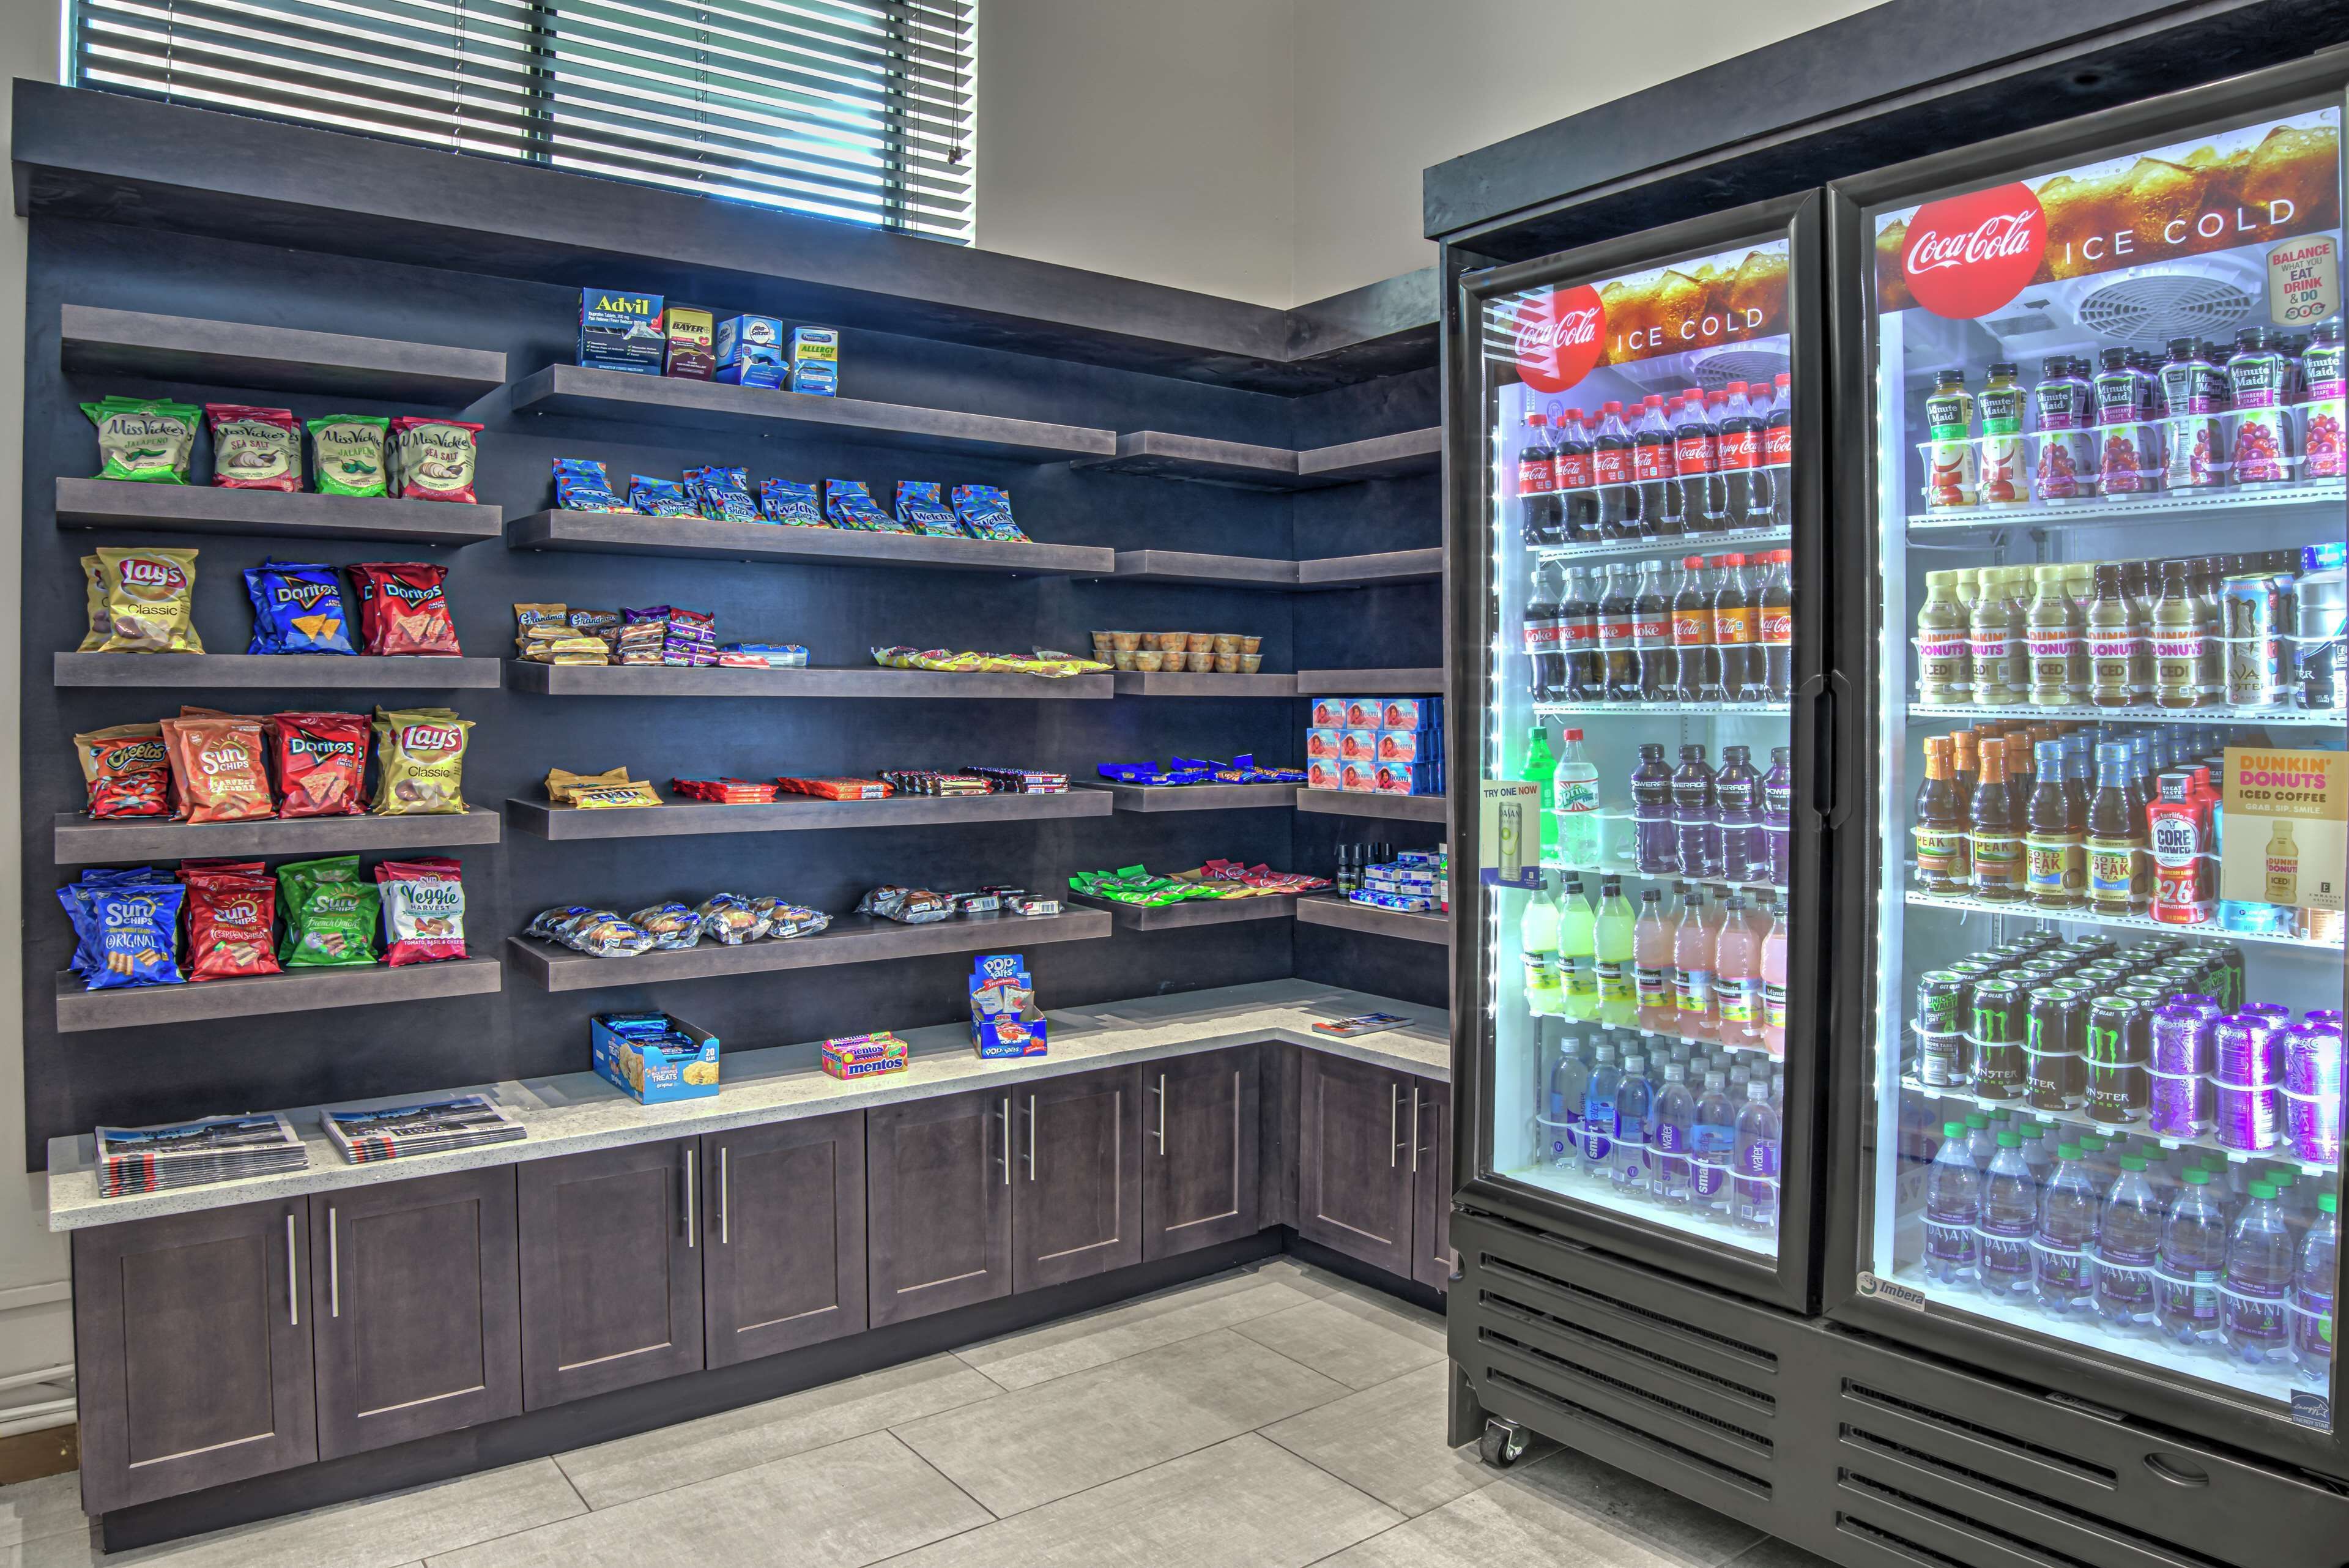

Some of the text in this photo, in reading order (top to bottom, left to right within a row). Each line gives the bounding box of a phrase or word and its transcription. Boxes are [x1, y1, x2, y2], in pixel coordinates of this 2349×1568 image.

[2065, 199, 2295, 265] ICE COLD
[1907, 208, 2039, 275] Coca-Cola
[2272, 243, 2331, 266] BALANCE
[2281, 256, 2323, 272] WHAT YOU
[2284, 277, 2323, 294] DRINK
[2290, 289, 2318, 304] & DO
[595, 295, 649, 315] Advil
[672, 322, 703, 333] BAYER
[1514, 305, 1600, 355] Coca-Cola
[1617, 308, 1763, 353] ICE COLD
[2303, 357, 2340, 370] Minute
[2232, 366, 2270, 378] Minute
[2235, 376, 2265, 387] Maid
[2098, 384, 2132, 395] Minute
[2100, 391, 2131, 403] Maid
[2041, 401, 2065, 410] Maid
[1932, 414, 1954, 422] Maid
[231, 440, 270, 450] SEA SALT
[425, 448, 459, 461] SEA SALT
[1679, 445, 1715, 461] Coca-Cola
[916, 511, 955, 521] Welch's
[121, 559, 182, 587] Lay's
[276, 583, 339, 603] Doritos
[385, 583, 443, 599] Doritos
[127, 603, 178, 616] Classic
[519, 612, 566, 625] Grandma's
[1526, 631, 1552, 642] Coke
[1633, 624, 1659, 637] Coke
[2151, 642, 2203, 656] DONUTS
[2037, 664, 2065, 676] ICED
[2096, 664, 2124, 677] ICED
[404, 726, 459, 749] Lay's
[291, 737, 355, 754] Doritos
[107, 742, 166, 770] Cheetos
[201, 748, 248, 775] Sun
[219, 760, 250, 771] CHIPS
[2240, 755, 2332, 773] DUNKIN'
[407, 766, 451, 778] Classic
[2240, 770, 2326, 789] DONUTS
[1483, 789, 1498, 798] TRY
[1518, 785, 1538, 795] NOW
[2239, 789, 2326, 803] ICED COFFEE
[2245, 803, 2324, 814] GRAB. SIP. SMILE.
[2157, 829, 2191, 846] CORE
[2028, 849, 2060, 858] GOLD
[2092, 855, 2128, 864] GOLD
[2028, 858, 2061, 870] PEAK
[2093, 862, 2129, 875] PEAK
[401, 885, 460, 904] Veggie
[314, 895, 360, 913] Sun
[105, 902, 157, 926] Sun
[123, 916, 154, 926] CHIPS
[306, 918, 333, 929] French
[105, 934, 160, 950] ORIGINAL
[989, 979, 1016, 987] Strawberry
[705, 1047, 715, 1057] 20
[822, 1049, 842, 1063] mentos
[888, 1046, 902, 1058] fruit
[848, 1058, 904, 1075] mentos
[1589, 1125, 1598, 1159] smart
[1661, 1123, 1674, 1150] water
[1753, 1144, 1764, 1173] water
[1699, 1159, 1709, 1194] smart
[1879, 1280, 1924, 1306] Imbera
[2293, 1416, 2329, 1430] ENERGY STAR
